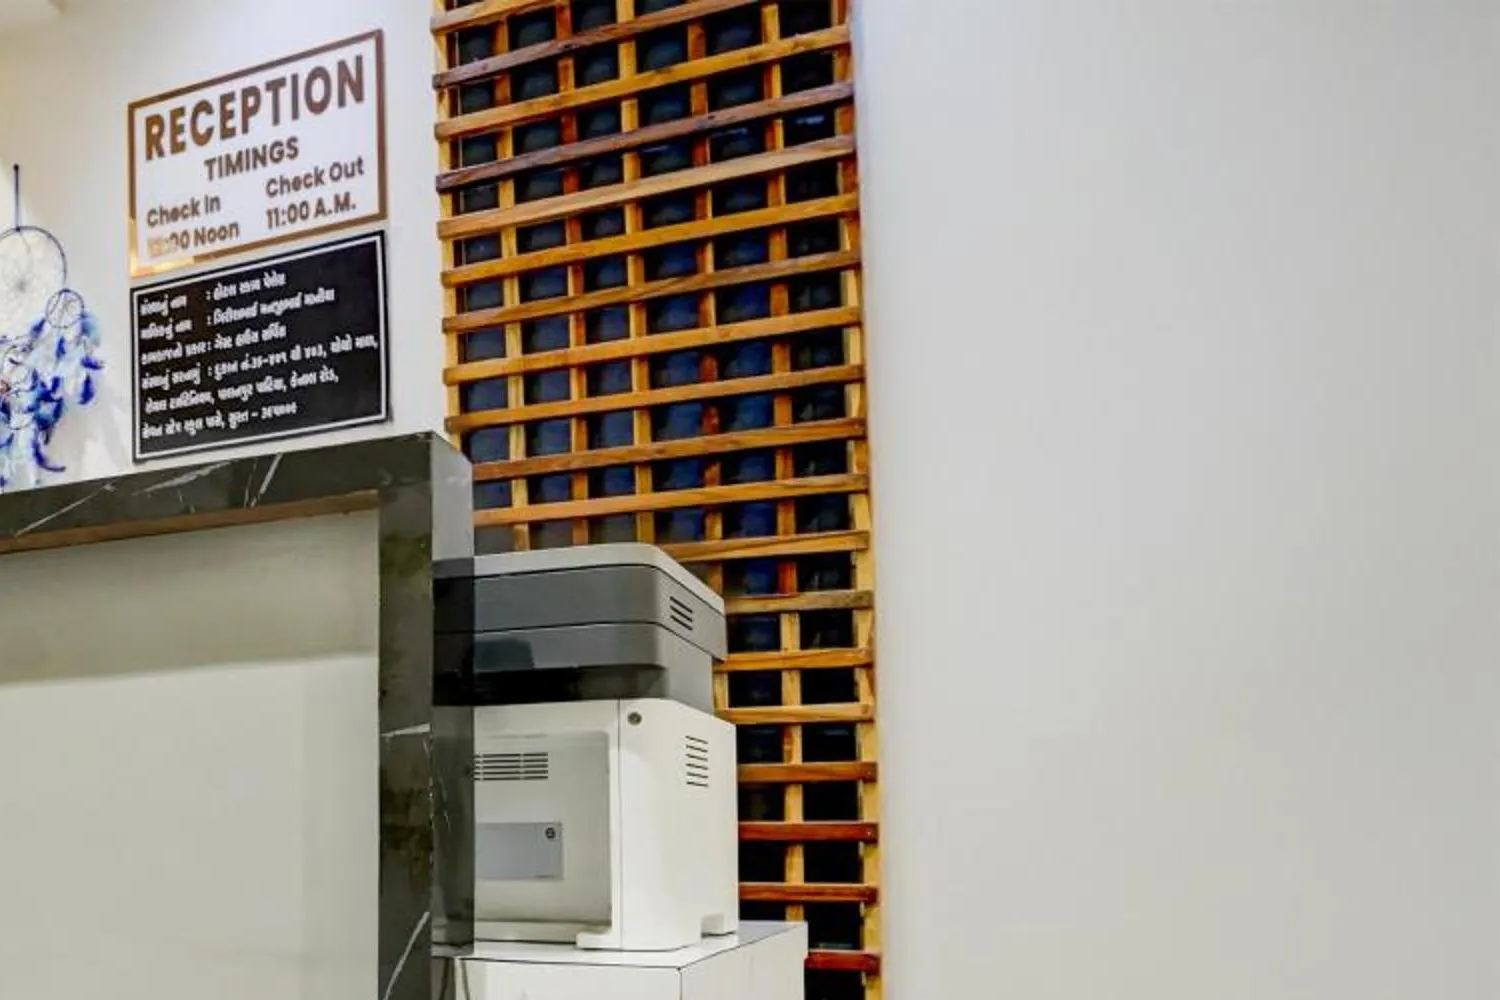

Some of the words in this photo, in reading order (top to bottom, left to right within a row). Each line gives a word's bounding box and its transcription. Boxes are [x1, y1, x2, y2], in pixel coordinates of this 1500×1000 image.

[145, 54, 364, 162] RECEPTION
[204, 136, 299, 181] TIMINGS
[266, 166, 325, 198] Check
[329, 156, 364, 182] Out
[147, 198, 200, 228] Check
[204, 195, 220, 214] In
[266, 200, 310, 229] 11:00
[314, 192, 356, 218] A.M.
[194, 222, 240, 247] Noon
